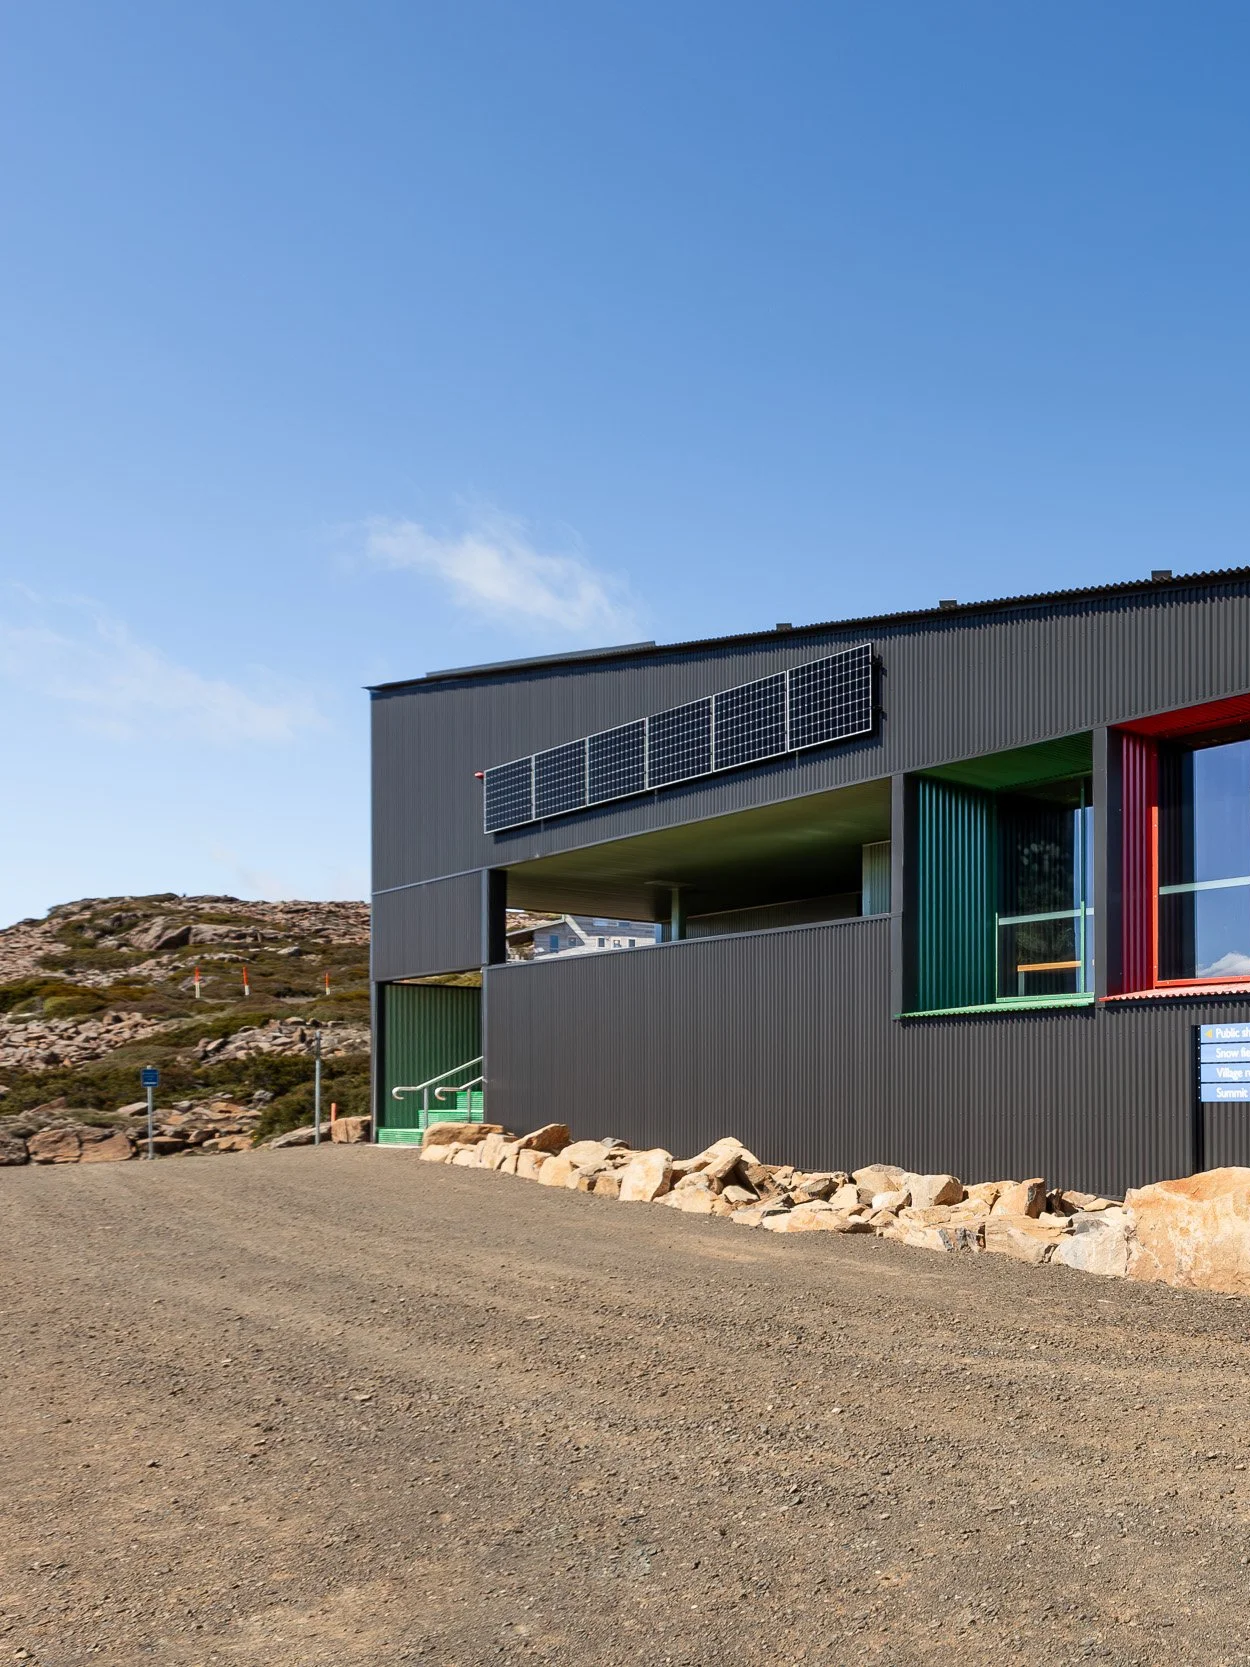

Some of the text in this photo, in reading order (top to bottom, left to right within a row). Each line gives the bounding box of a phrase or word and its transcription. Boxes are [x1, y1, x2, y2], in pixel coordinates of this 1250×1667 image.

[1216, 1028, 1240, 1038] Public
[1216, 1048, 1239, 1058] Snow
[1216, 1068, 1243, 1080] Village
[1216, 1088, 1248, 1098] Summit
